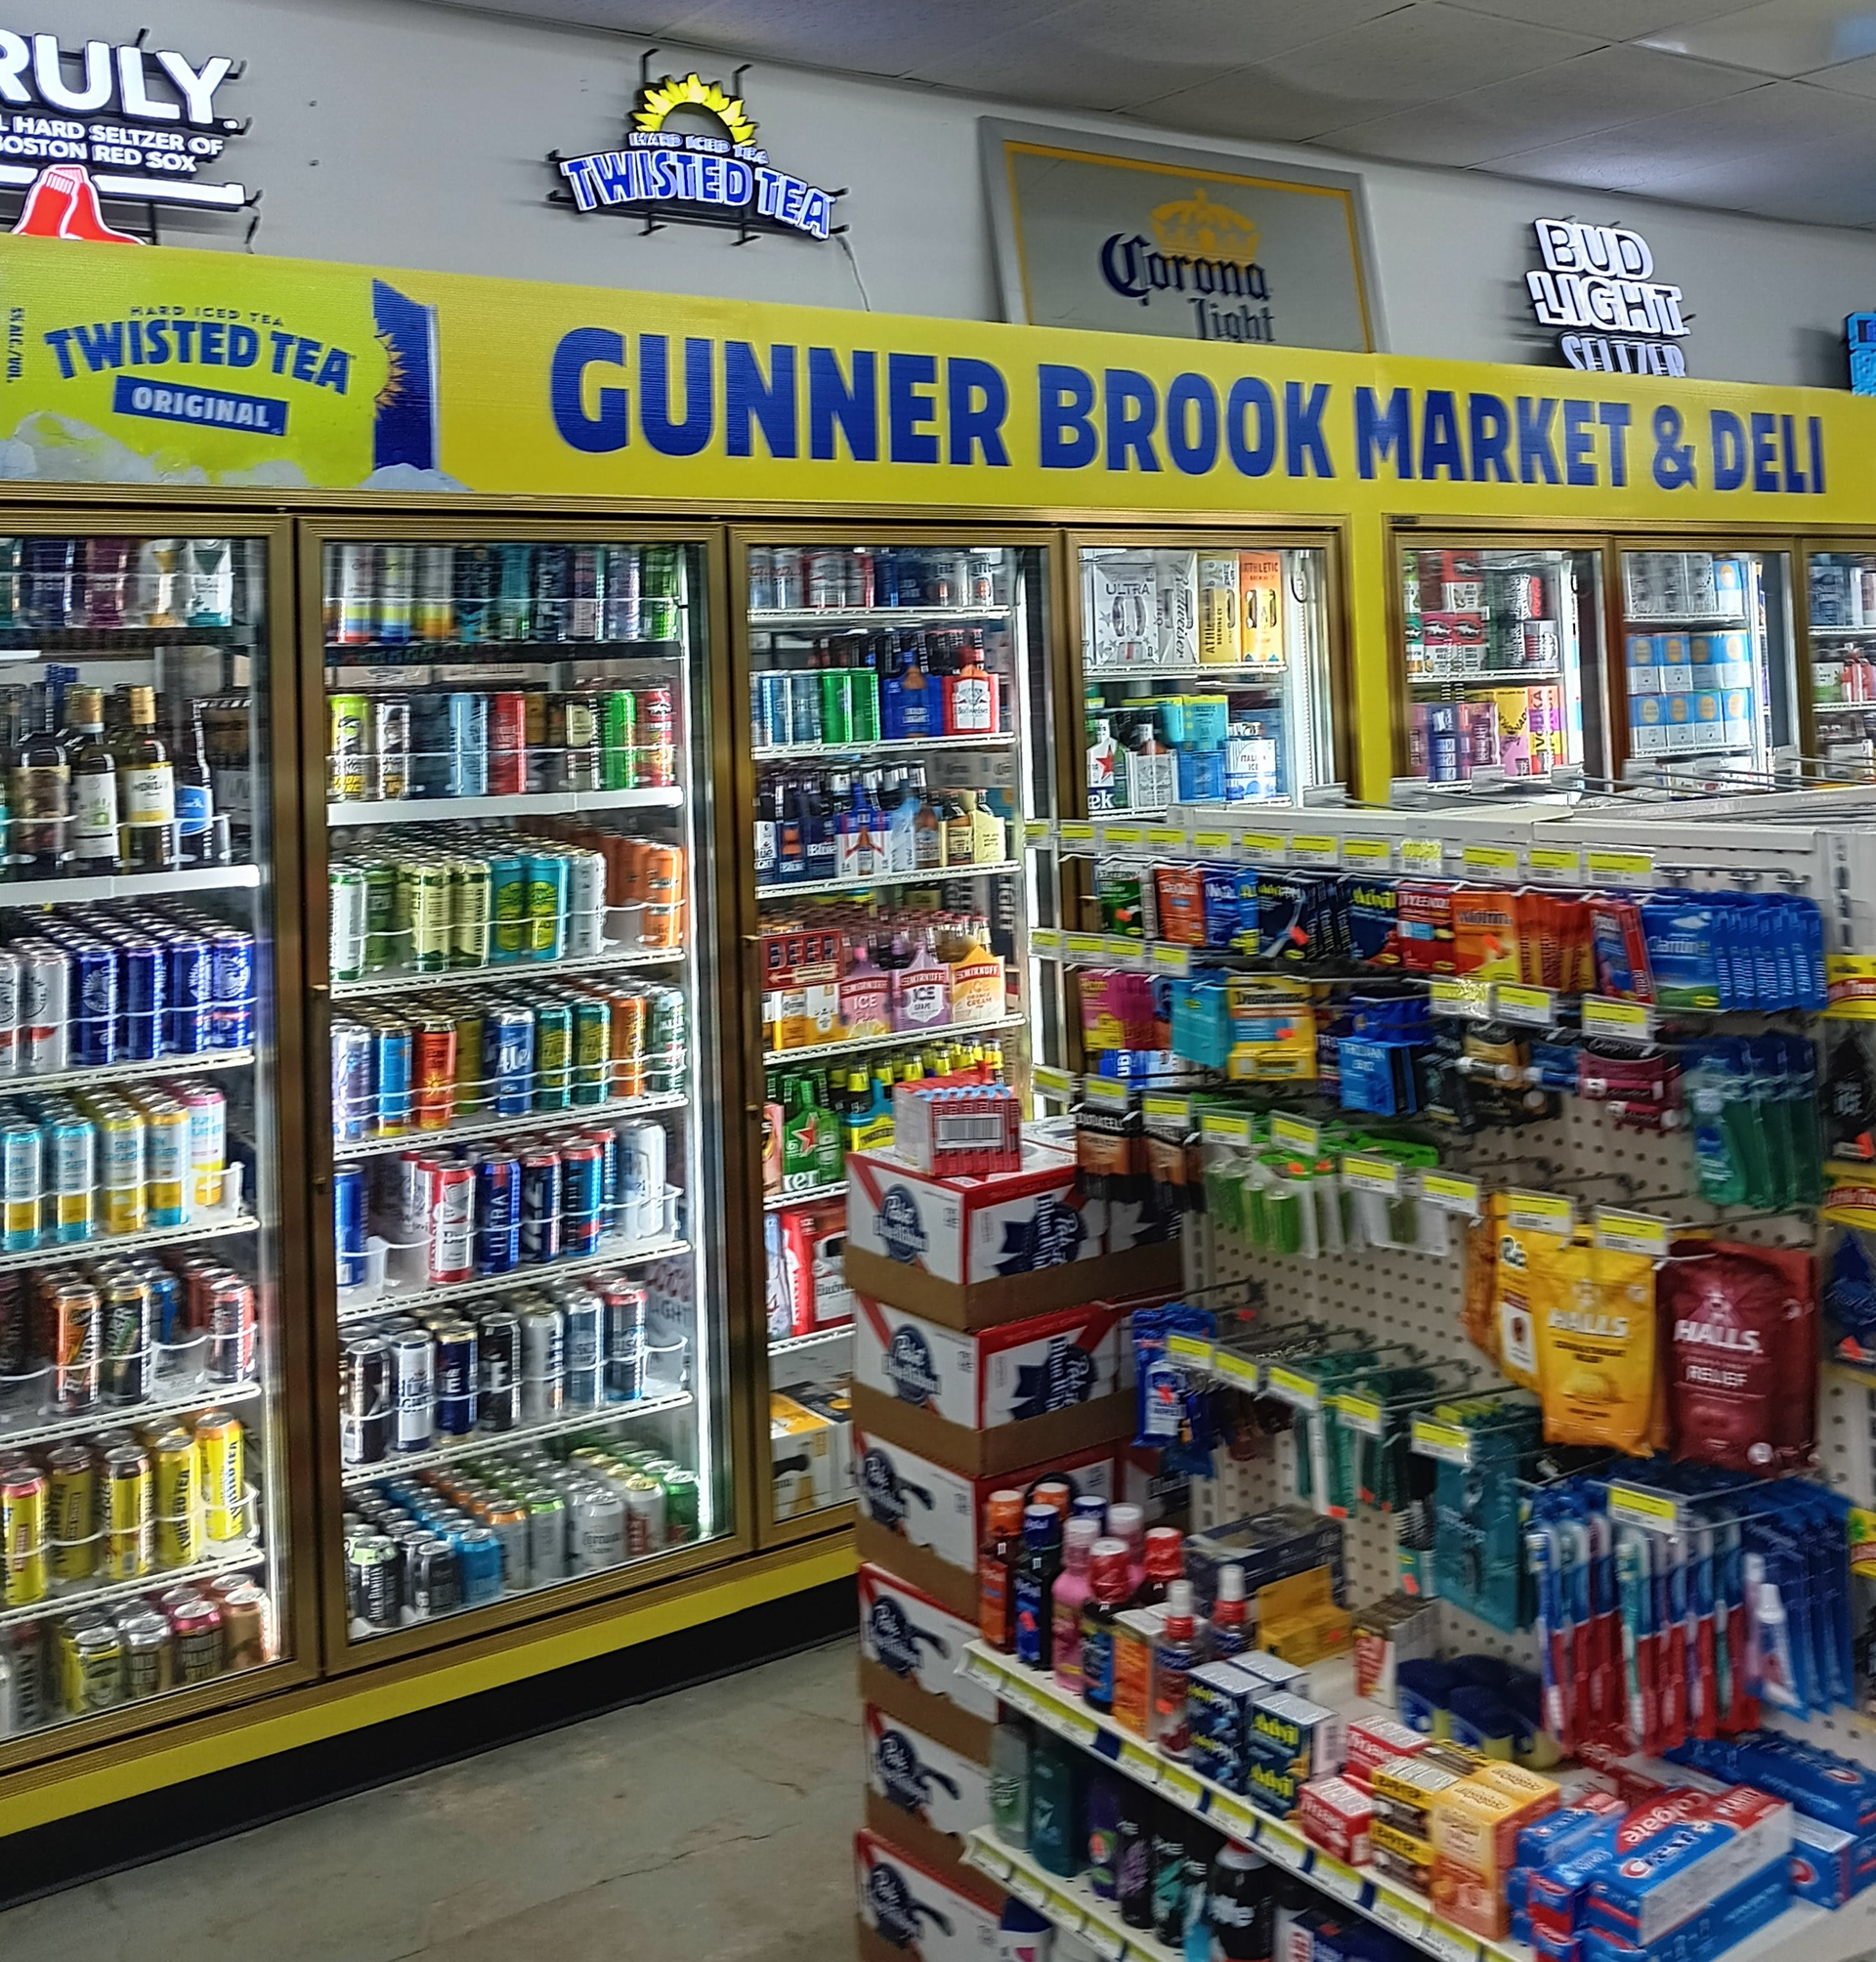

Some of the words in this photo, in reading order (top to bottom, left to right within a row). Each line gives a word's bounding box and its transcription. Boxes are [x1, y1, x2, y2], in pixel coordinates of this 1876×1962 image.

[13, 115, 86, 140] HARD
[89, 124, 186, 151] SELTZER
[188, 136, 225, 156] OF
[628, 132, 684, 148] HARD
[685, 134, 731, 153] ICED
[732, 144, 770, 165] TEA
[91, 144, 143, 167] RED
[146, 150, 197, 173] SOX
[559, 149, 753, 212] TWISTED
[754, 165, 833, 240] TEA
[1534, 218, 1655, 281] BUD
[1100, 232, 1272, 308] Corona
[129, 306, 187, 317] HARD
[193, 306, 241, 320] ICED
[249, 312, 285, 327] TEA
[1186, 296, 1276, 343] Light
[1525, 270, 1684, 336] LIGHT
[44, 319, 260, 380] TWISTED
[270, 329, 353, 396] TEA
[131, 386, 271, 428] ORIGINAL
[549, 326, 1013, 468] GUNNER
[1038, 362, 1337, 480] BROOK
[1355, 384, 1632, 489] MARKET
[1651, 404, 1697, 491] &
[1711, 406, 1825, 495] DELI
[1242, 562, 1279, 574] ATHLETIC
[1105, 583, 1150, 595] ULTRA
[902, 972, 946, 987] SMIRNOFF
[956, 965, 1000, 981] SMIRNOFF
[968, 980, 990, 993] ICE
[853, 995, 877, 1010] ICE
[913, 987, 936, 1002] ICE
[966, 997, 993, 1008] CREAM
[490, 1194, 509, 1258] ULTRA
[1547, 1307, 1630, 1339] HALLS
[1685, 1365, 1748, 1386] RELIEF
[1252, 1713, 1300, 1746] Advil
[1250, 1763, 1295, 1799] Advil
[1621, 1791, 1711, 1846] Colgate
